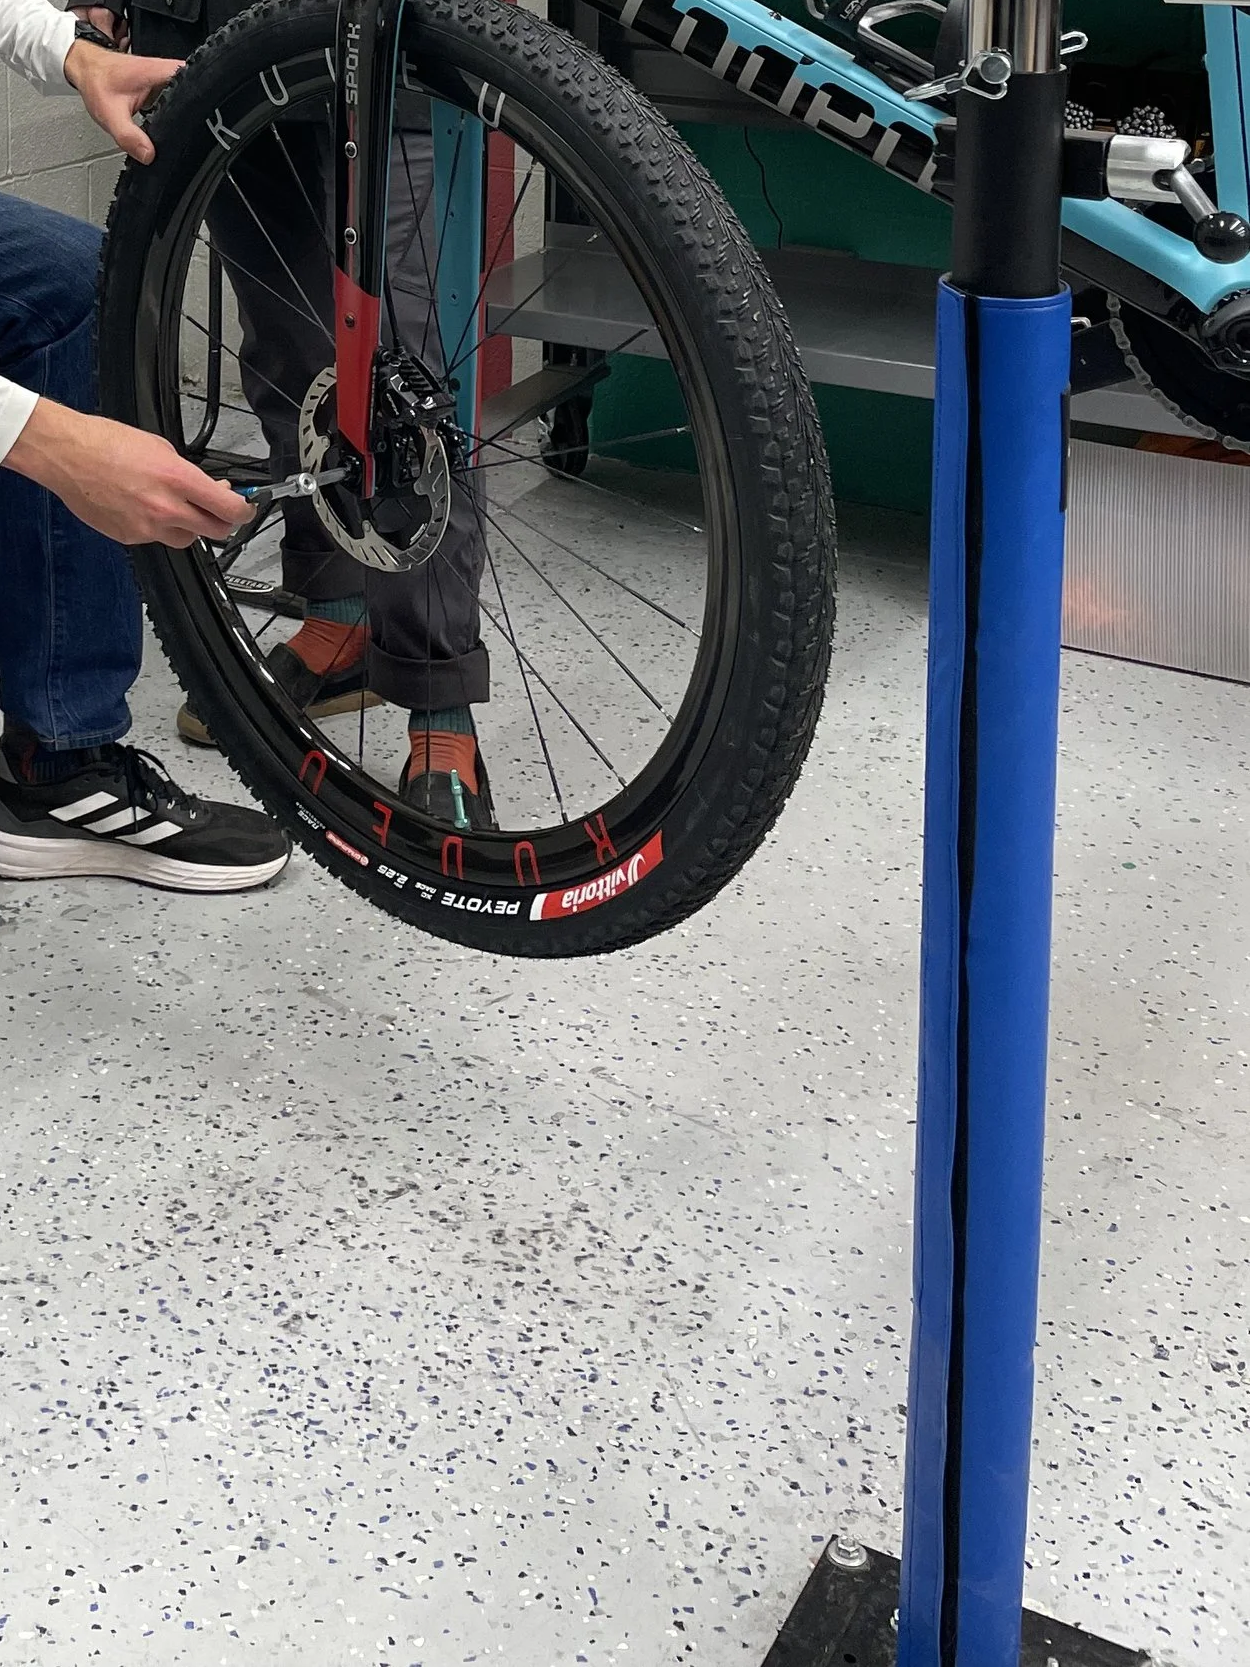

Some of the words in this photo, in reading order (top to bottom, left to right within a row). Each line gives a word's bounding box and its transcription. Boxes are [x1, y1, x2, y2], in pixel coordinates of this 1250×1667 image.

[297, 809, 320, 830] RACE
[376, 864, 409, 885] 2.25
[414, 881, 437, 895] RACE
[561, 870, 629, 912] vittoria
[441, 891, 521, 916] PEYOTE
